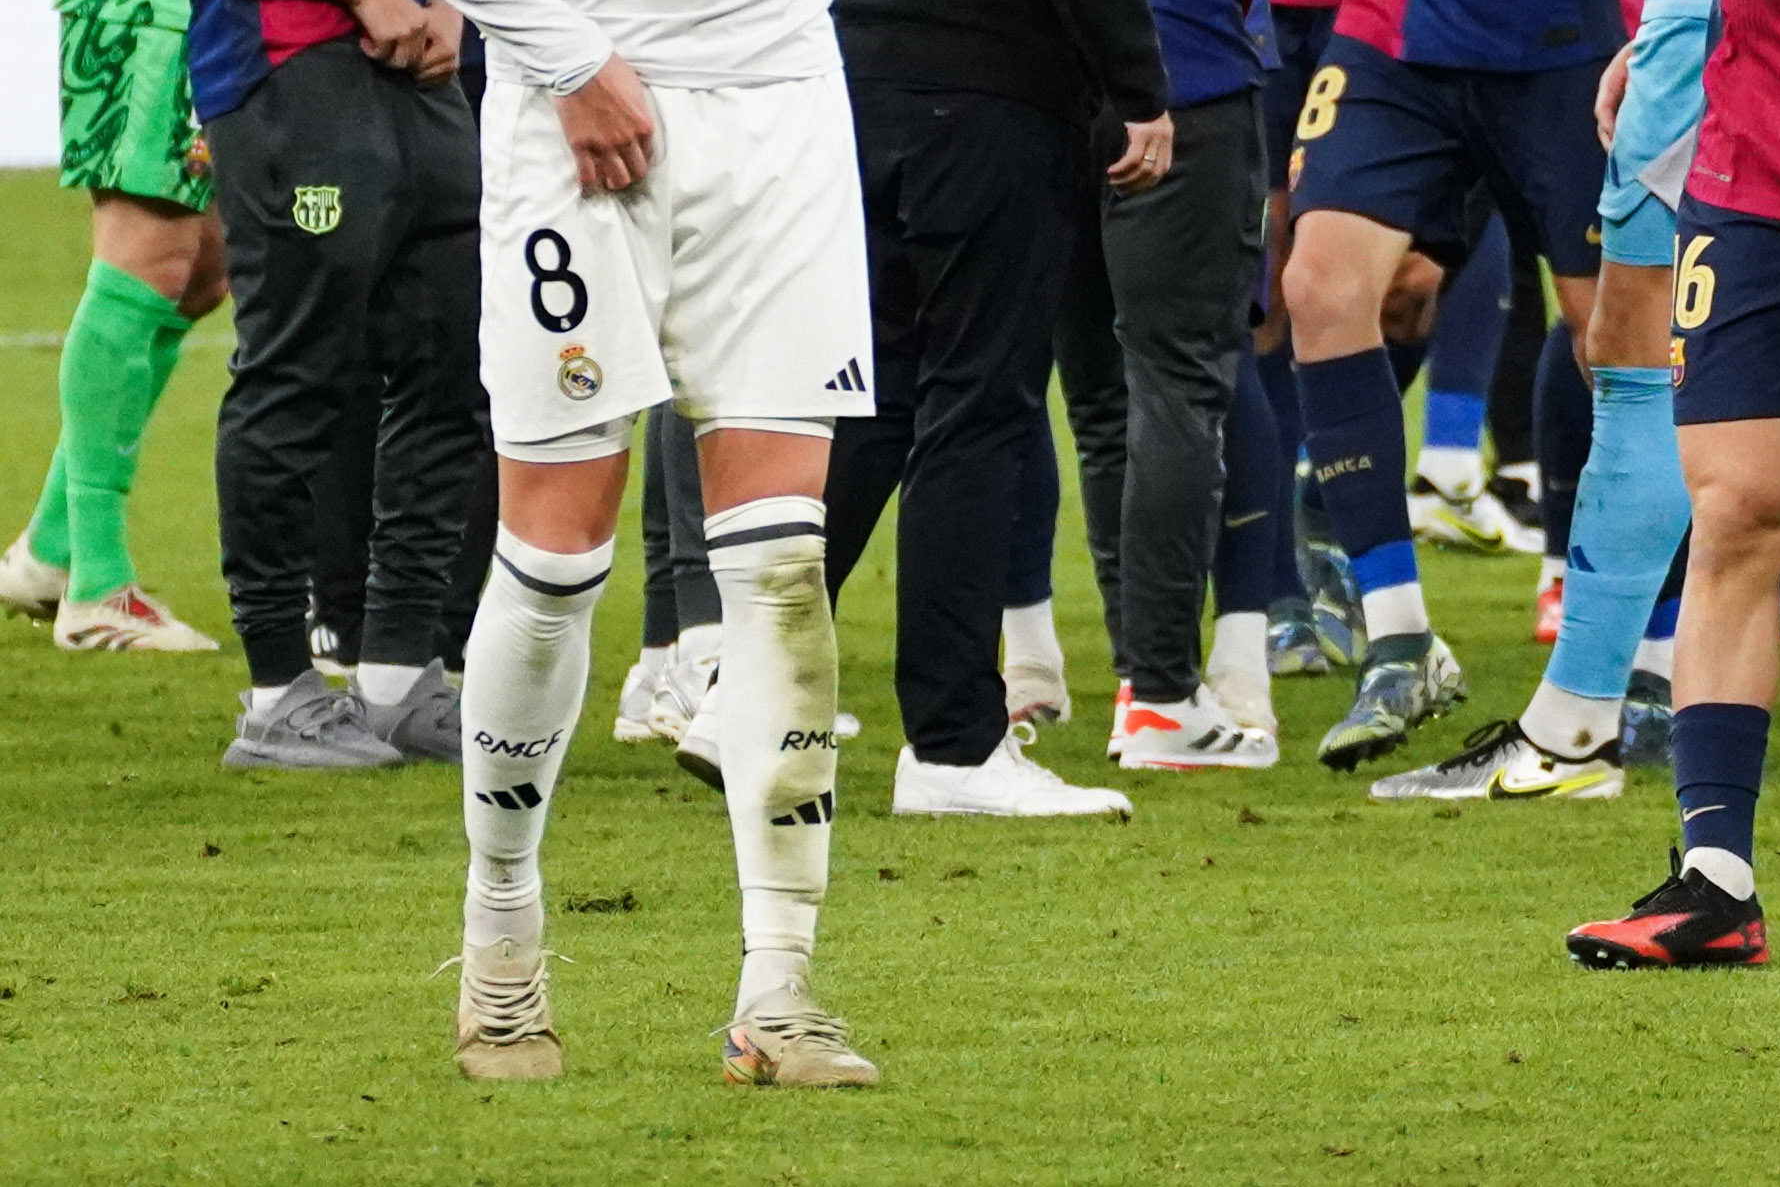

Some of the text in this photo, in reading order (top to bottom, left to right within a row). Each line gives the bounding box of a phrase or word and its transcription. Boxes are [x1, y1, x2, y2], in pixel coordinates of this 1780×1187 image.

[1297, 65, 1347, 140] 8
[525, 228, 588, 333] 8
[474, 729, 564, 758] RMCF
